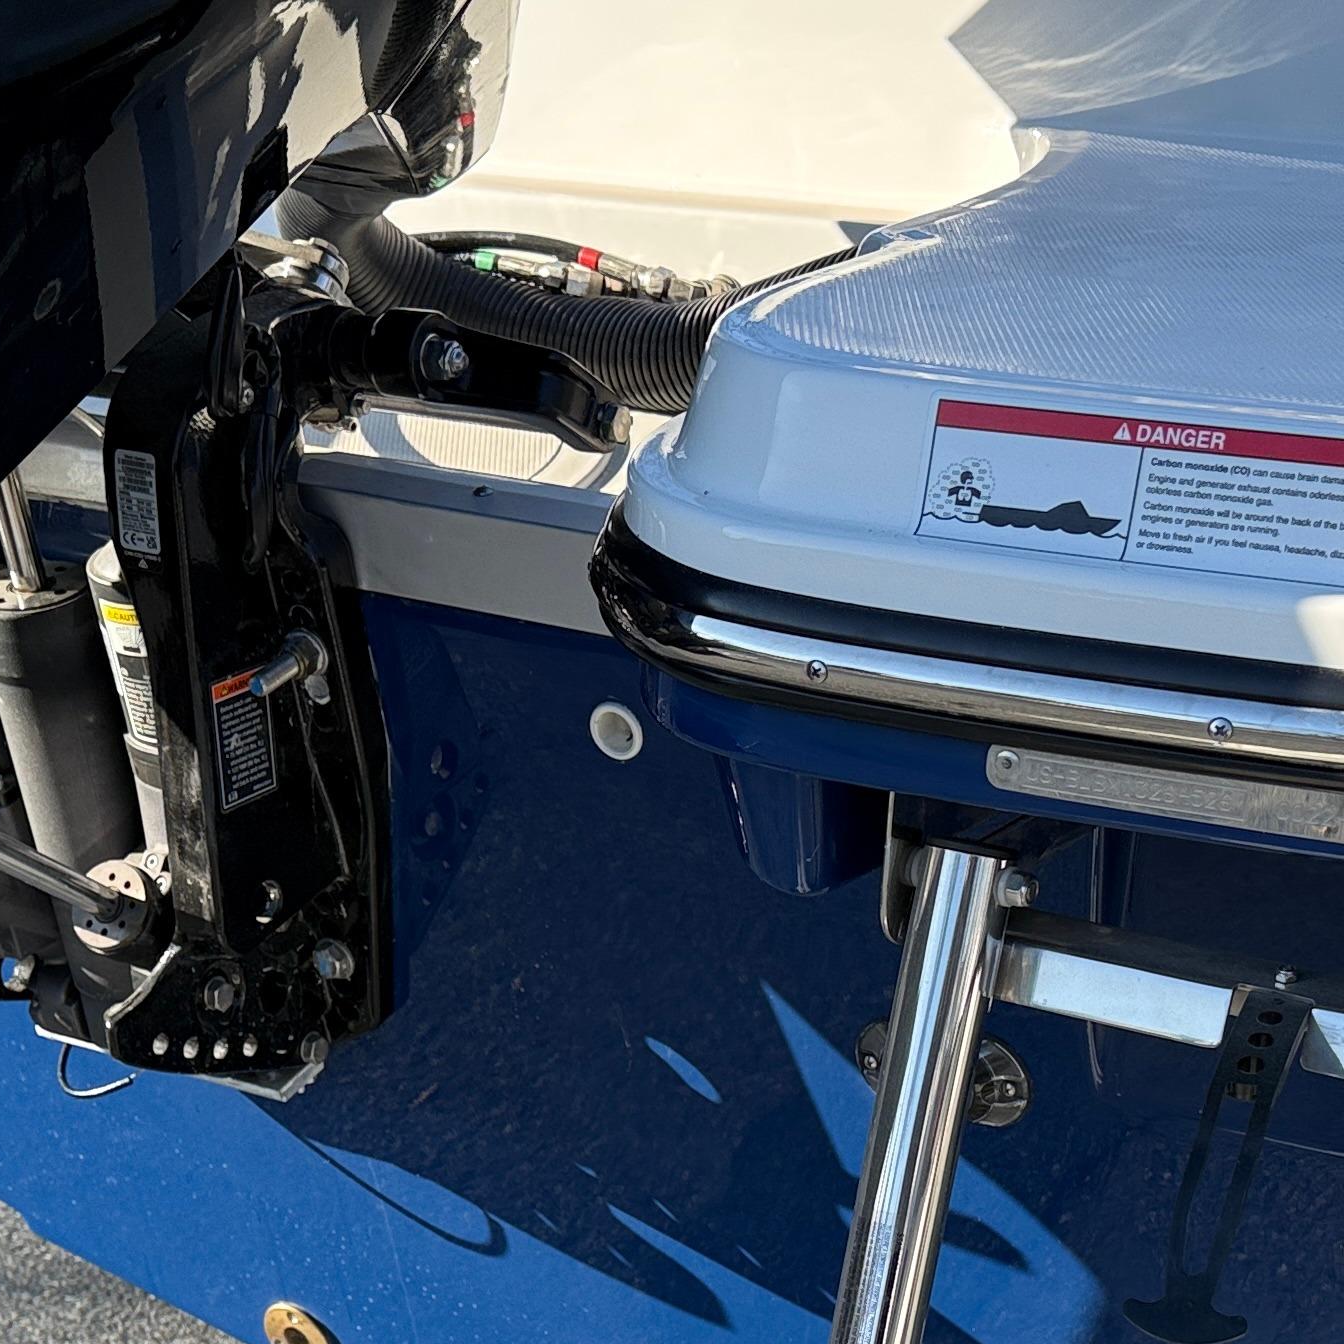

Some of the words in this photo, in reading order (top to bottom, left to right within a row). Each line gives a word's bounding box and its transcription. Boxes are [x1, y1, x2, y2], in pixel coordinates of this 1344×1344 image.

[1136, 424, 1226, 450] DANGER
[1151, 458, 1182, 468] Carbon
[1185, 462, 1228, 473] monoxide
[1231, 466, 1250, 477] (CO)
[1253, 469, 1268, 477] can
[1270, 471, 1295, 480] cause
[1297, 473, 1319, 482] brain
[1146, 486, 1181, 496] colorless
[1184, 490, 1211, 500] carbon
[1214, 493, 1254, 504] monoxide
[1148, 473, 1176, 484] Engine
[1178, 477, 1194, 486] and
[1196, 480, 1236, 489] generator
[1237, 483, 1271, 494] exhaust
[1272, 487, 1307, 498] contains
[1309, 491, 1344, 502] odorless
[1141, 514, 1173, 523] engines
[1185, 519, 1229, 530] generators
[1231, 524, 1244, 532] are
[1247, 526, 1280, 537] running.
[1144, 501, 1173, 512] Carbon
[1175, 505, 1214, 516] monoxide
[1217, 509, 1230, 518] will
[1232, 511, 1242, 519] be
[1244, 513, 1274, 522] around
[1276, 516, 1289, 525] the
[1291, 517, 1311, 527] back
[1313, 520, 1323, 528] of
[1324, 521, 1337, 530] the
[1139, 529, 1160, 538] Move
[1163, 531, 1171, 539] to
[1173, 532, 1193, 542] fresh
[1195, 535, 1205, 543] air
[1215, 539, 1229, 547] you
[1232, 539, 1247, 548] feel
